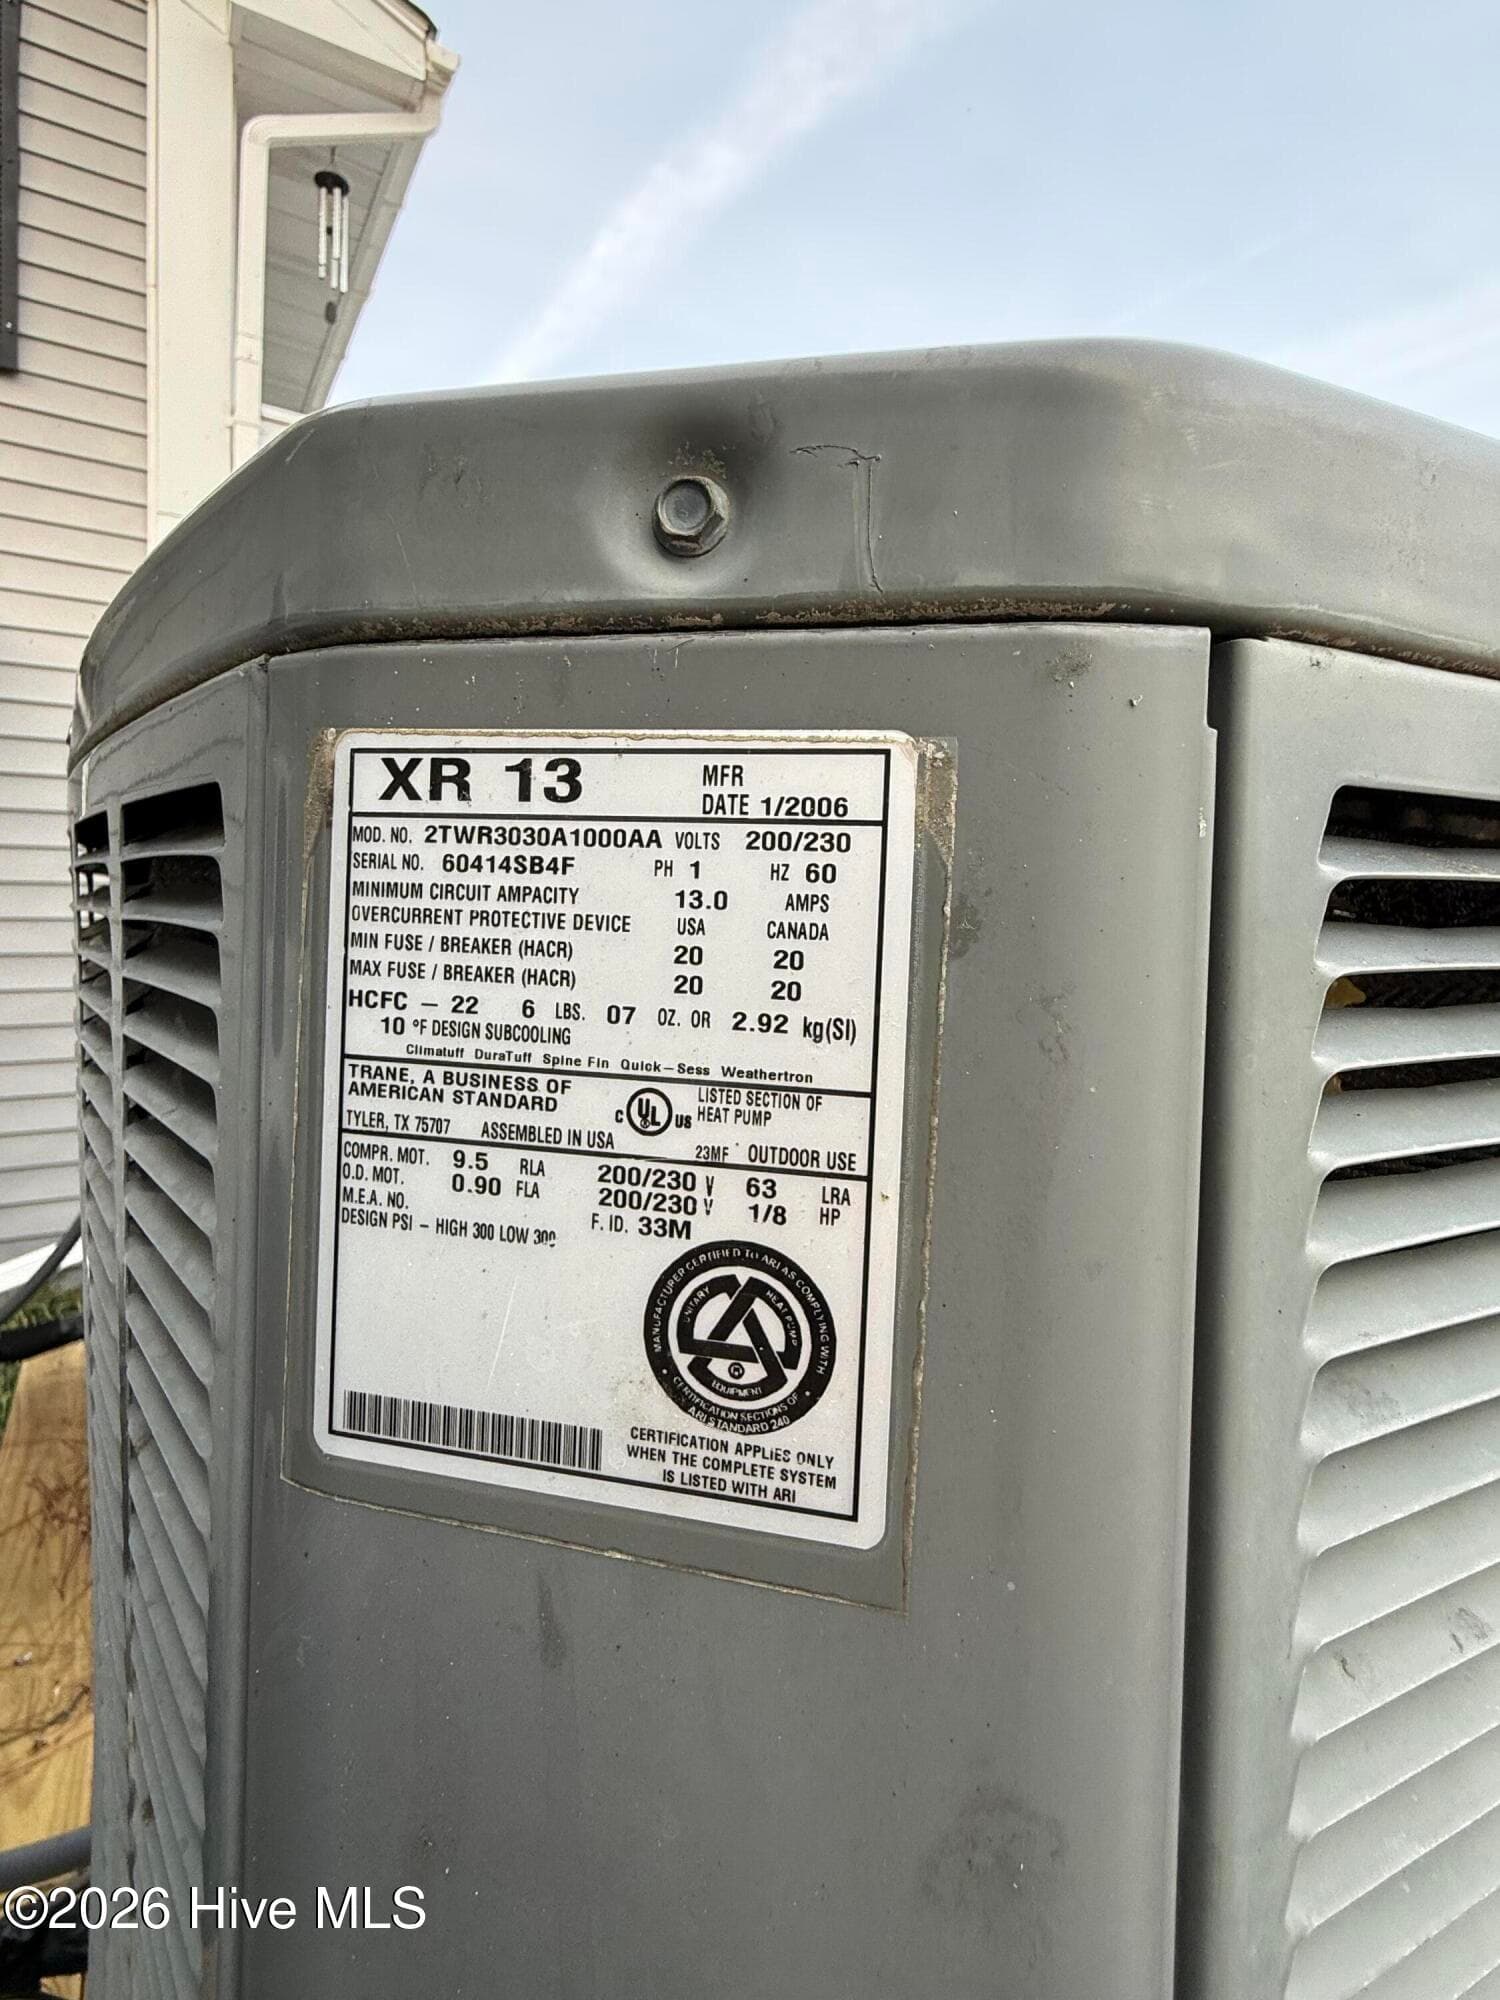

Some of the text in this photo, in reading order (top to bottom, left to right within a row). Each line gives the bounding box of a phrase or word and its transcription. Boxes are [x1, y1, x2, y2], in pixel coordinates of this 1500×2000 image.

[378, 757, 582, 803] XR 13
[703, 765, 744, 786] MFR
[702, 794, 849, 817] DATE 1/2006
[352, 825, 663, 849] MOD. NO. 2TWR3030A1000AA
[675, 831, 851, 853] VOLTS 200/230
[353, 853, 575, 875] SERIAL NO. 60414SB4F
[654, 860, 700, 879] PH 1
[770, 863, 837, 884] HZ 60
[352, 881, 579, 904] MINIMUM CIRCUIT AMPACITY
[675, 889, 728, 910] 13.0
[785, 894, 829, 912] AMPS
[352, 906, 631, 932] OVERCURRENT PROTECTIVE DEVICE
[677, 917, 705, 936] USA
[767, 921, 829, 940] CANADA
[350, 932, 573, 961] MIN FUSE / BREAKER (HACR)
[674, 945, 703, 966] 20
[773, 950, 804, 971] 20
[350, 959, 576, 990] MAX FUSE / BREAKER (HACR)
[674, 975, 703, 995] 20
[771, 981, 802, 1001] 20
[349, 989, 408, 1010] HCFC
[451, 995, 478, 1014] 22
[522, 1000, 535, 1018] 6
[555, 1003, 585, 1021] LBS.
[607, 1005, 636, 1025] 07
[657, 1008, 681, 1027] OZ.
[691, 1010, 711, 1028] OR
[732, 1011, 789, 1034] 2.92
[381, 1017, 405, 1035] 10
[432, 1019, 480, 1038] DESIGN
[485, 1023, 571, 1045] SUBCOOLING
[406, 1044, 464, 1058] Climatuff
[474, 1049, 532, 1063] DuraTuff
[543, 1054, 581, 1068] Spine
[587, 1057, 609, 1069] Fin
[721, 1065, 813, 1083] Weathertron
[349, 1064, 572, 1094] TRANE, A BUSINESS OF
[349, 1081, 558, 1112] AMERICAN STANDARD
[698, 1088, 823, 1111] LISTED SECTION OF
[347, 1110, 450, 1134] TYLER, TX 75707
[698, 1106, 772, 1127] HEAT PUMP
[481, 1122, 614, 1149] ASSEMBLED IN USA
[344, 1142, 545, 1177] COMPR. MOT. 9.5 RLA
[695, 1145, 729, 1163] 23MF
[748, 1144, 856, 1171] OUTDOOR USE
[342, 1164, 539, 1198] O.D. MOT. 0.90 FLA
[598, 1164, 714, 1196] 200/230 V
[746, 1177, 777, 1199] 63
[387, 1192, 408, 1209] NO.
[599, 1188, 697, 1216] 200/230
[822, 1186, 851, 1206] LRA
[342, 1208, 387, 1228] DESIGN
[392, 1213, 413, 1231] PSI
[436, 1218, 468, 1237] HIGH
[473, 1222, 494, 1240] 300
[499, 1225, 529, 1244] LOW
[748, 1205, 786, 1226] 1/8
[819, 1207, 840, 1226] HP
[638, 1217, 691, 1240] 33M
[770, 1415, 790, 1430] 240
[630, 1426, 834, 1469] CERTIFICATION APPLIES ONLY
[627, 1444, 837, 1490] WHEN THE COMPLETE SYSTEM
[662, 1470, 796, 1503] IS LISTED WITH ARI
